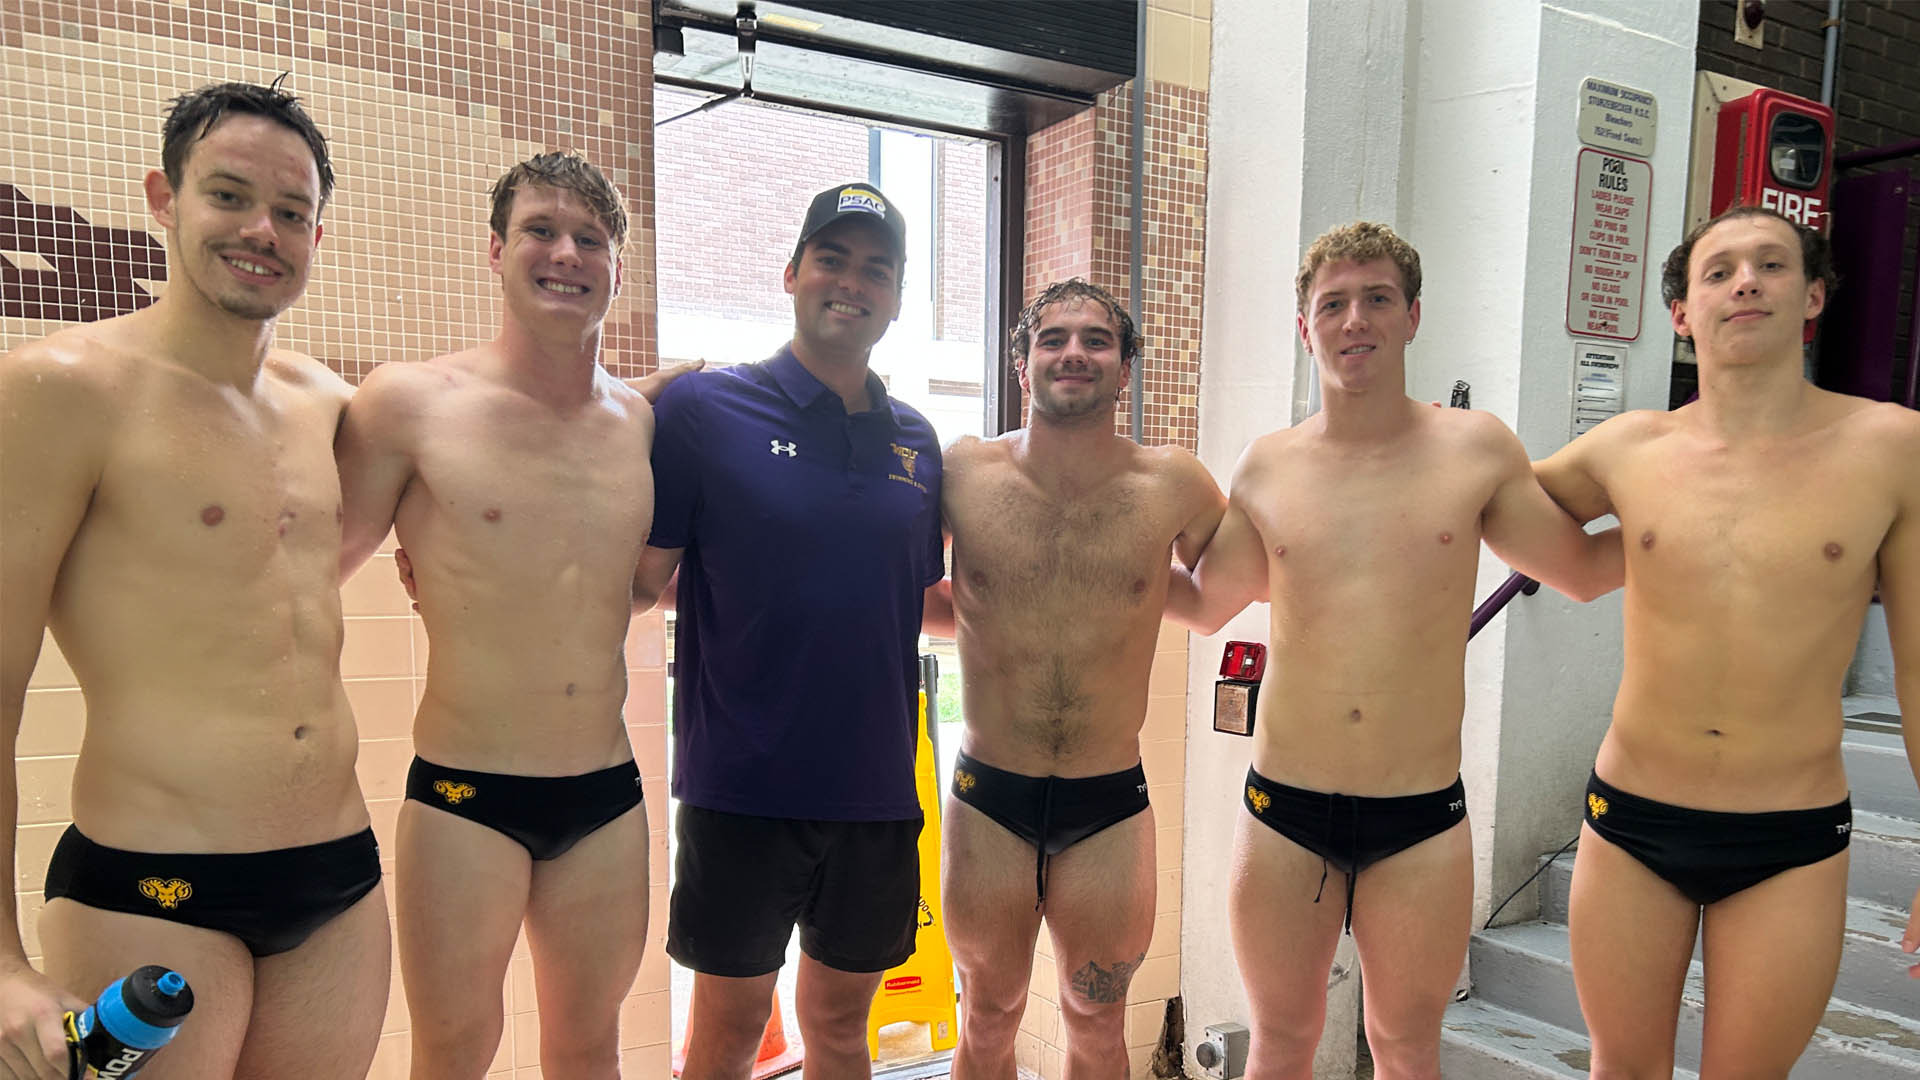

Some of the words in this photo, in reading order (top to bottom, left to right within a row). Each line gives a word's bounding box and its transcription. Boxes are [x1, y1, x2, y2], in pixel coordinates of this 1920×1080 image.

[1587, 81, 1618, 96] MAXIMUM
[1603, 157, 1626, 175] POOL
[1598, 173, 1629, 192] RULES
[840, 195, 885, 212] PSAC
[1592, 189, 1612, 201] LADIES
[1613, 194, 1635, 206] PLEASE
[1595, 203, 1612, 214] WEAR
[1614, 207, 1629, 217] CAPS
[1761, 187, 1822, 230] FIRE
[1594, 219, 1603, 229] NO
[1619, 224, 1628, 233] OR
[1589, 230, 1606, 241] CLIPS
[1607, 234, 1614, 243] IN
[1615, 235, 1630, 246] POOL
[1579, 246, 1597, 256] DON'T
[1599, 249, 1611, 259] RUN
[1612, 251, 1621, 260] ON
[1623, 253, 1638, 263] DECK
[1584, 264, 1593, 274] NO
[1595, 266, 1614, 277] ROUGH
[1615, 270, 1632, 279] PLAY
[1592, 282, 1600, 291] NO
[1602, 283, 1620, 294] GLASS
[1581, 292, 1589, 301] OR
[1606, 296, 1612, 304] IN
[1614, 297, 1629, 307] POOL
[1589, 310, 1597, 319] NO
[1599, 311, 1619, 322] EATING
[1448, 799, 1464, 812] TYR
